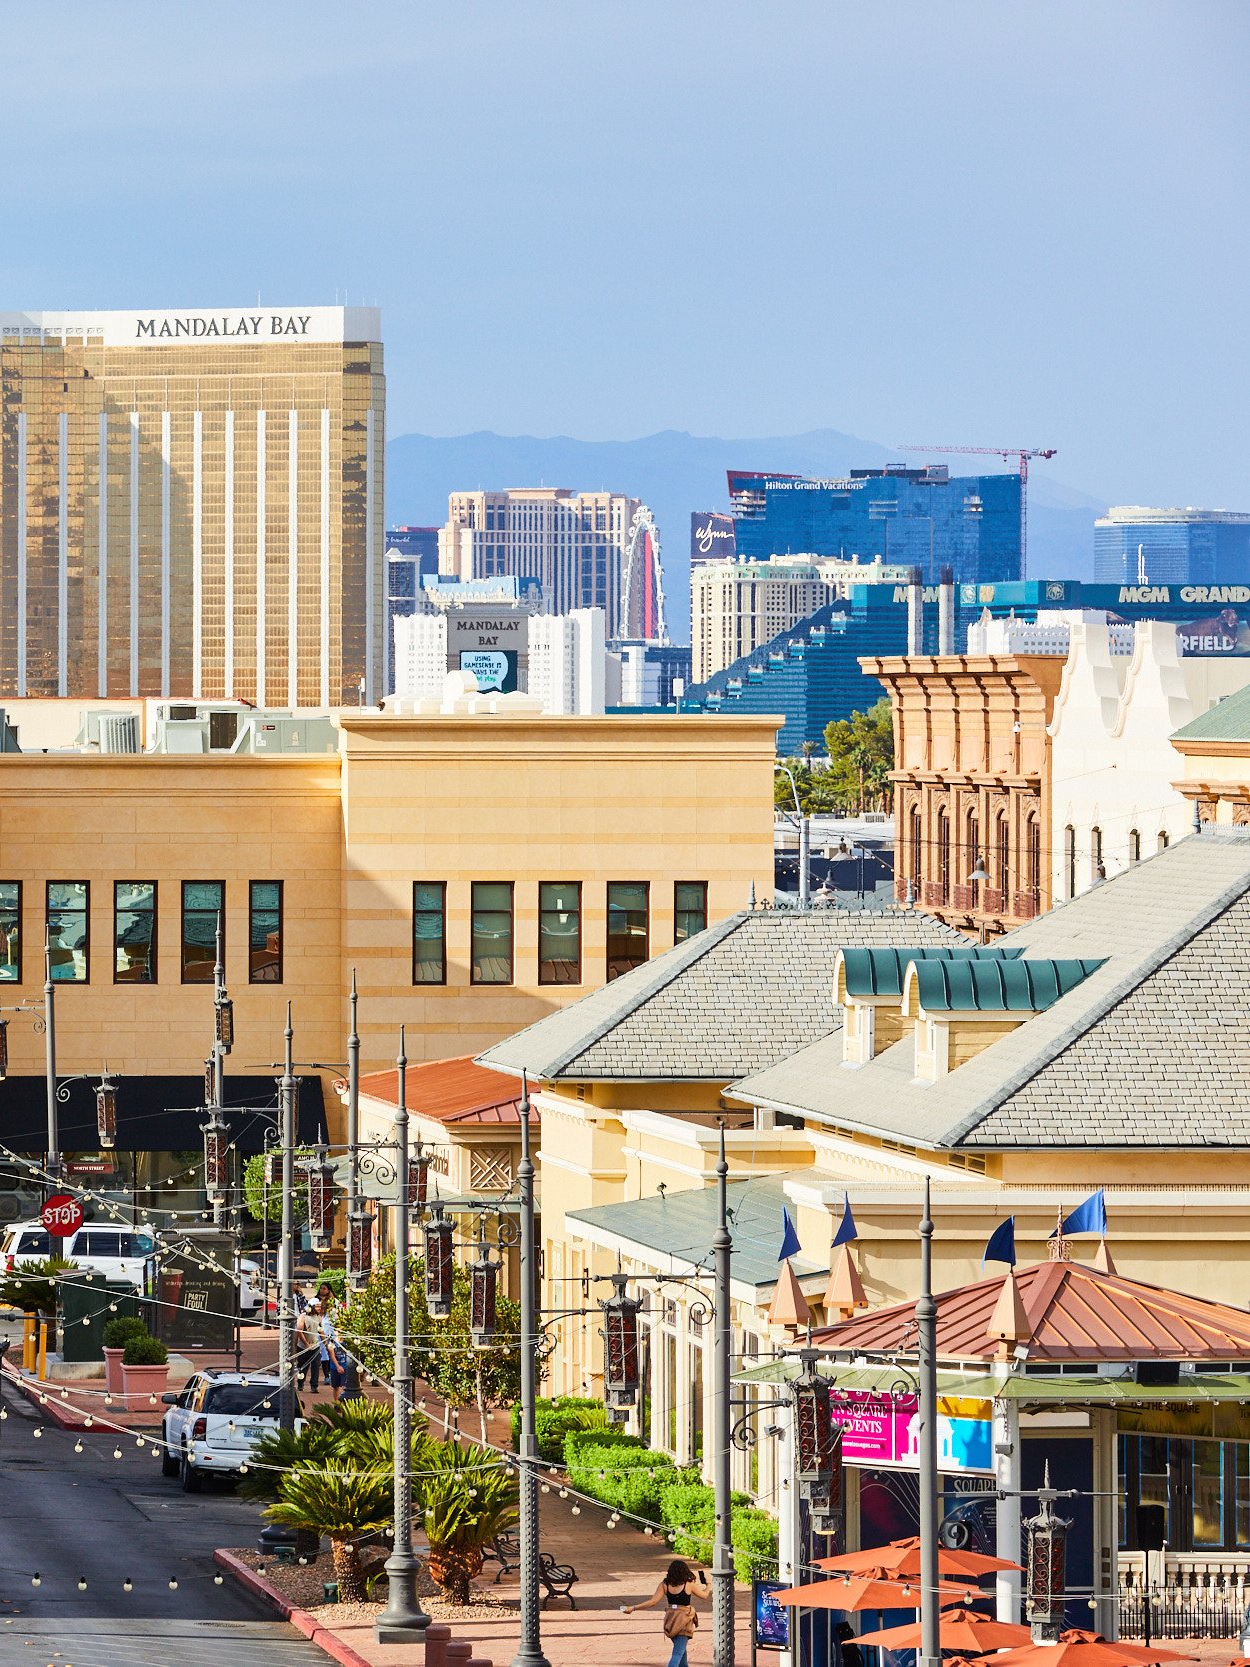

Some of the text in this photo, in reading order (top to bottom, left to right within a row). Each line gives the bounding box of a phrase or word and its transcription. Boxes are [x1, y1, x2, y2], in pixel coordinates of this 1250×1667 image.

[135, 316, 312, 338] MANDALAY BAY
[765, 481, 864, 490] Hilton Grand Vacations
[892, 586, 940, 603] MM
[1118, 586, 1250, 603] MGM GRAND
[457, 621, 520, 631] MANDALAY
[478, 636, 499, 645] BAY
[44, 1207, 81, 1224] STOP
[187, 1293, 206, 1302] PARTY
[187, 1299, 204, 1310] FOUL
[846, 1403, 888, 1419] SQUARE
[1148, 1401, 1164, 1411] THE
[1165, 1402, 1200, 1414] SQUARE
